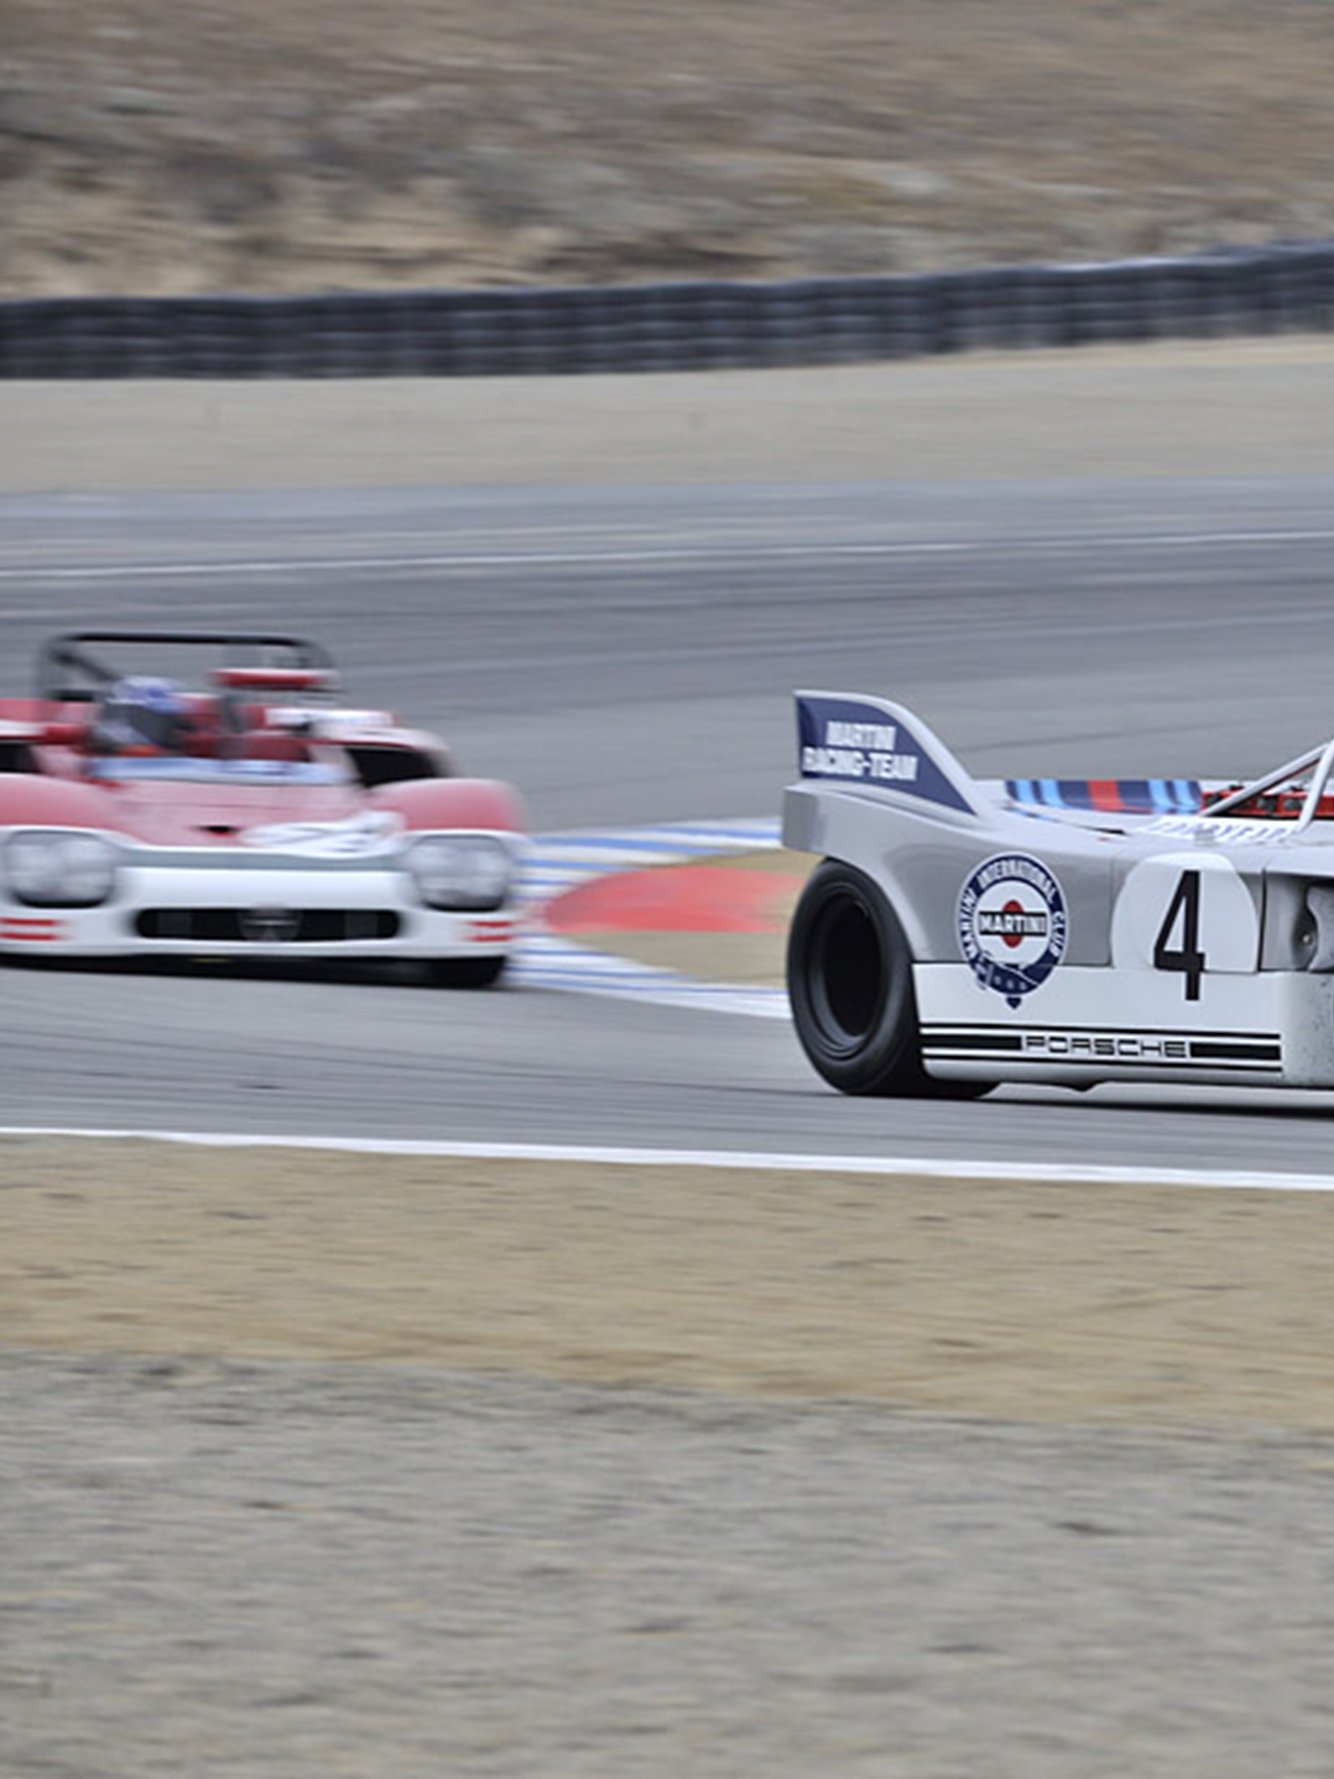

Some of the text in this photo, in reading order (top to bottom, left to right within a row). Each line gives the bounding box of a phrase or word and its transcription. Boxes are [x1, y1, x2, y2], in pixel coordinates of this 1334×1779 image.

[826, 720, 897, 750] MARTINI
[979, 912, 1047, 935] MARTINI
[1153, 869, 1206, 1001] 4
[1025, 1036, 1188, 1059] PORSCHE
